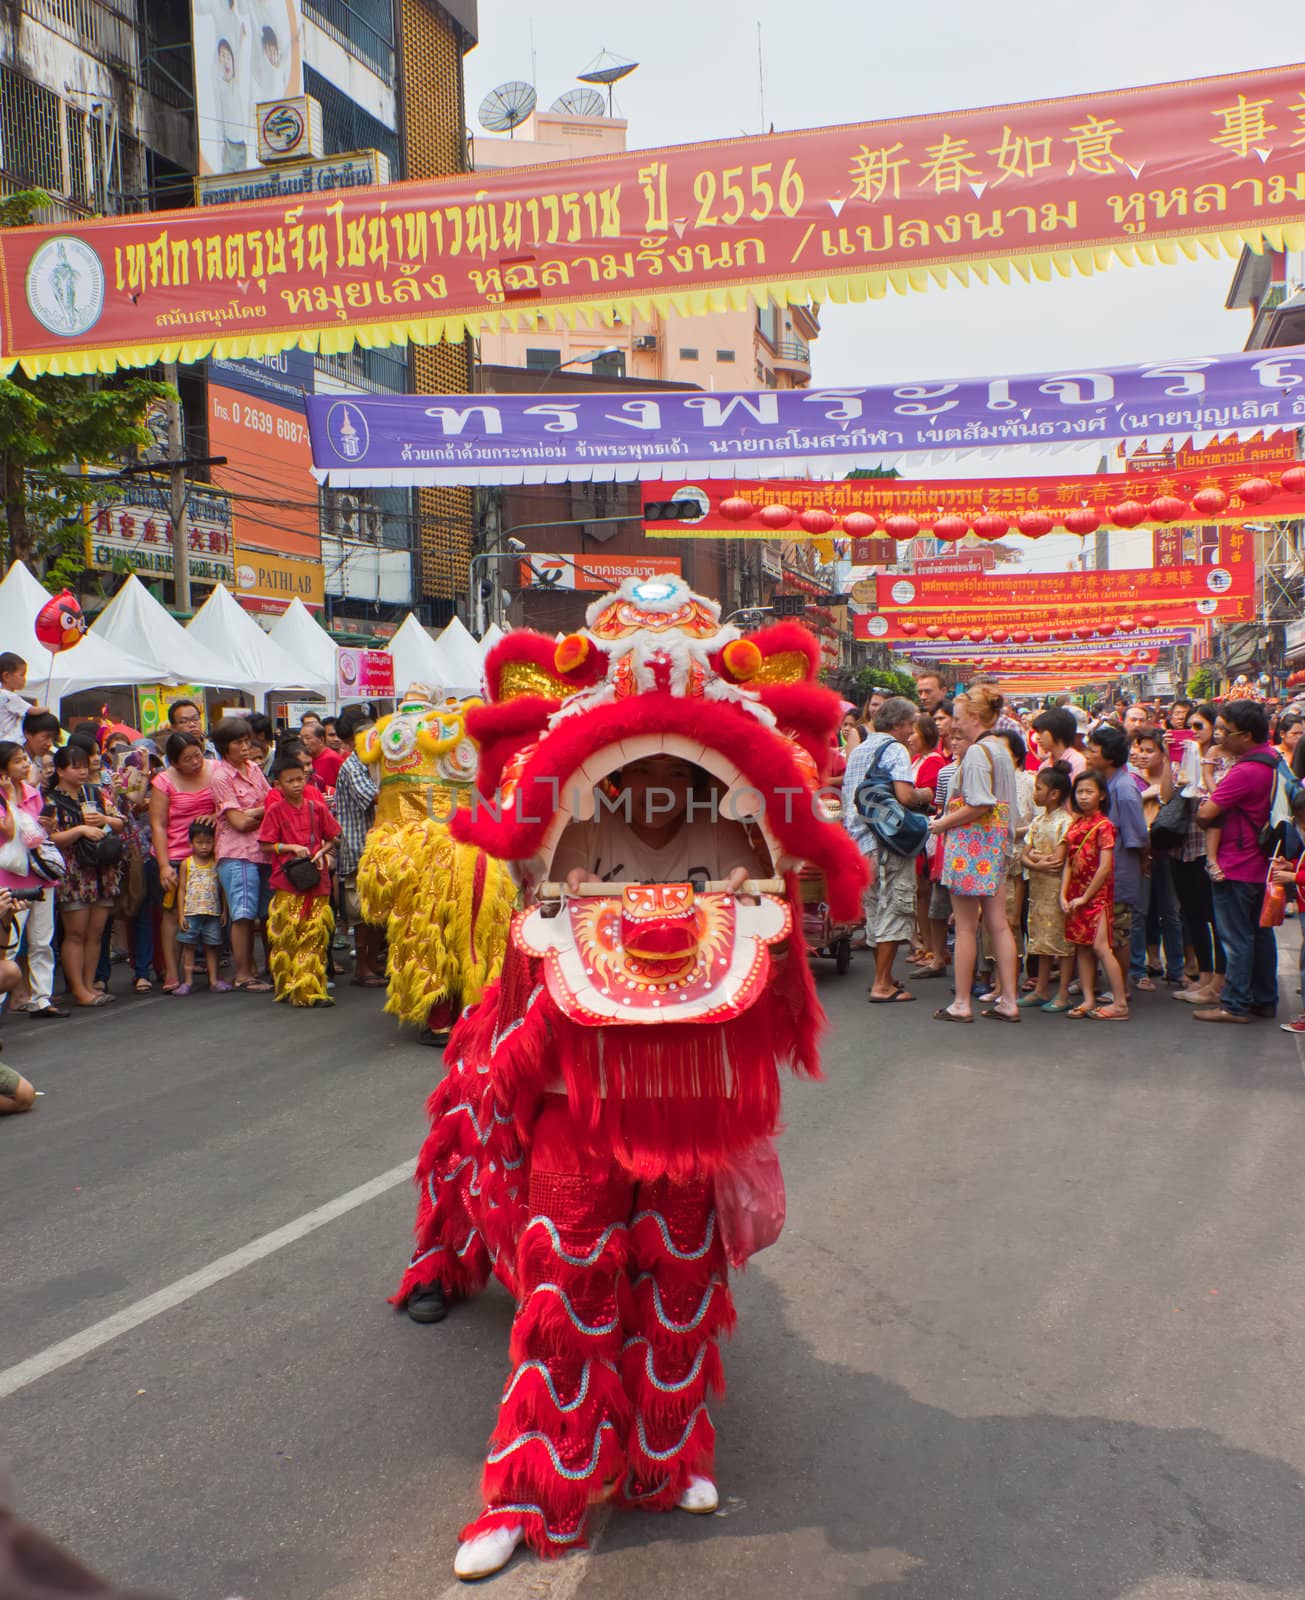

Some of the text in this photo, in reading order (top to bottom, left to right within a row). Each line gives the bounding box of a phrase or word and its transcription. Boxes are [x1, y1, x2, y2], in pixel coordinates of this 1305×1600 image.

[848, 90, 1305, 202] 新春如意 事
[638, 162, 668, 233] ปี
[693, 158, 804, 229] 2556
[155, 300, 267, 328] สนับสนุนโดย
[281, 264, 447, 321] หมุยเล้ง
[232, 402, 240, 424] 0
[244, 406, 272, 435] 2639
[401, 441, 566, 462] ด้วยเกล้าด้วยกระหม่อม
[576, 437, 689, 459] ข้าพระพุทธเจ้า
[989, 487, 1040, 504] 2556
[258, 567, 312, 594] PATHLAB
